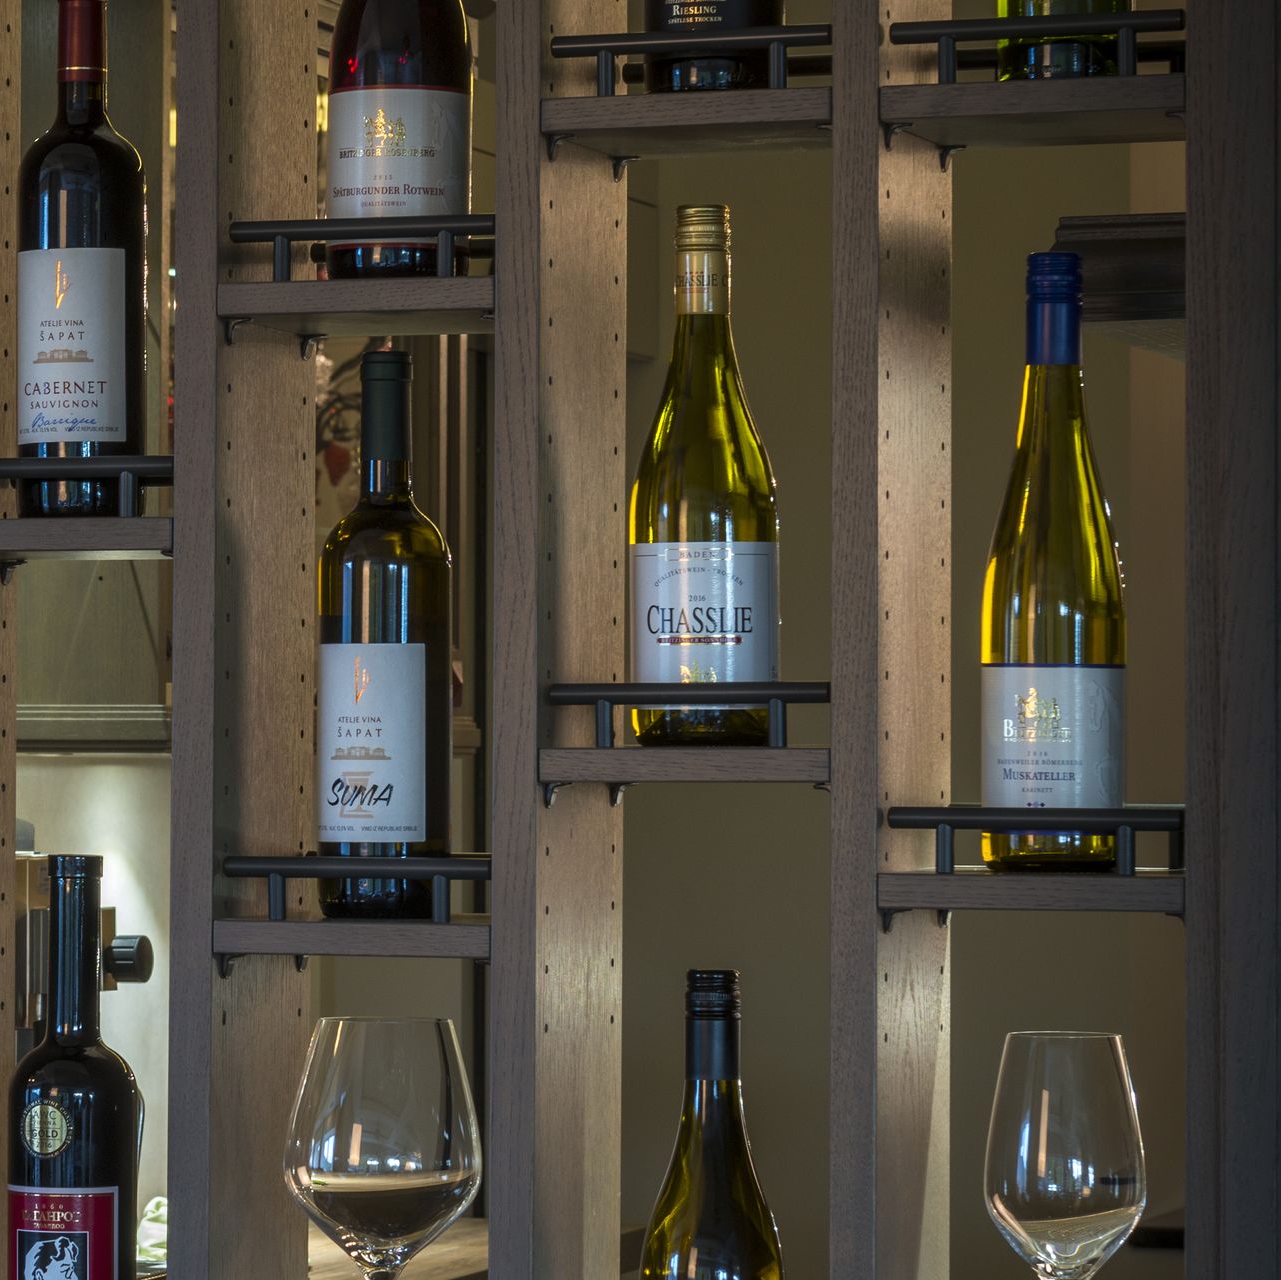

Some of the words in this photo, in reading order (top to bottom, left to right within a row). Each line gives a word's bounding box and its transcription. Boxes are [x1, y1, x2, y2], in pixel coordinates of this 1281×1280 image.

[672, 4, 717, 16] RIESLING
[332, 186, 400, 198] SPÄTBURGUNDER
[403, 183, 446, 197] ROTWEIN
[39, 320, 62, 328] ATELJE
[64, 319, 85, 327] VINA
[39, 330, 86, 342] ŠAPAT
[24, 380, 107, 396] CABERNET
[30, 399, 99, 410] SAUVIGNON
[31, 412, 97, 432] Barrique
[689, 594, 706, 602] 2016
[647, 605, 753, 634] CHASSLIE
[337, 726, 383, 738] ŠAPAT
[1002, 767, 1076, 781] MUSKATELLER
[326, 777, 394, 807] SUMA
[32, 1129, 59, 1138] GOLD
